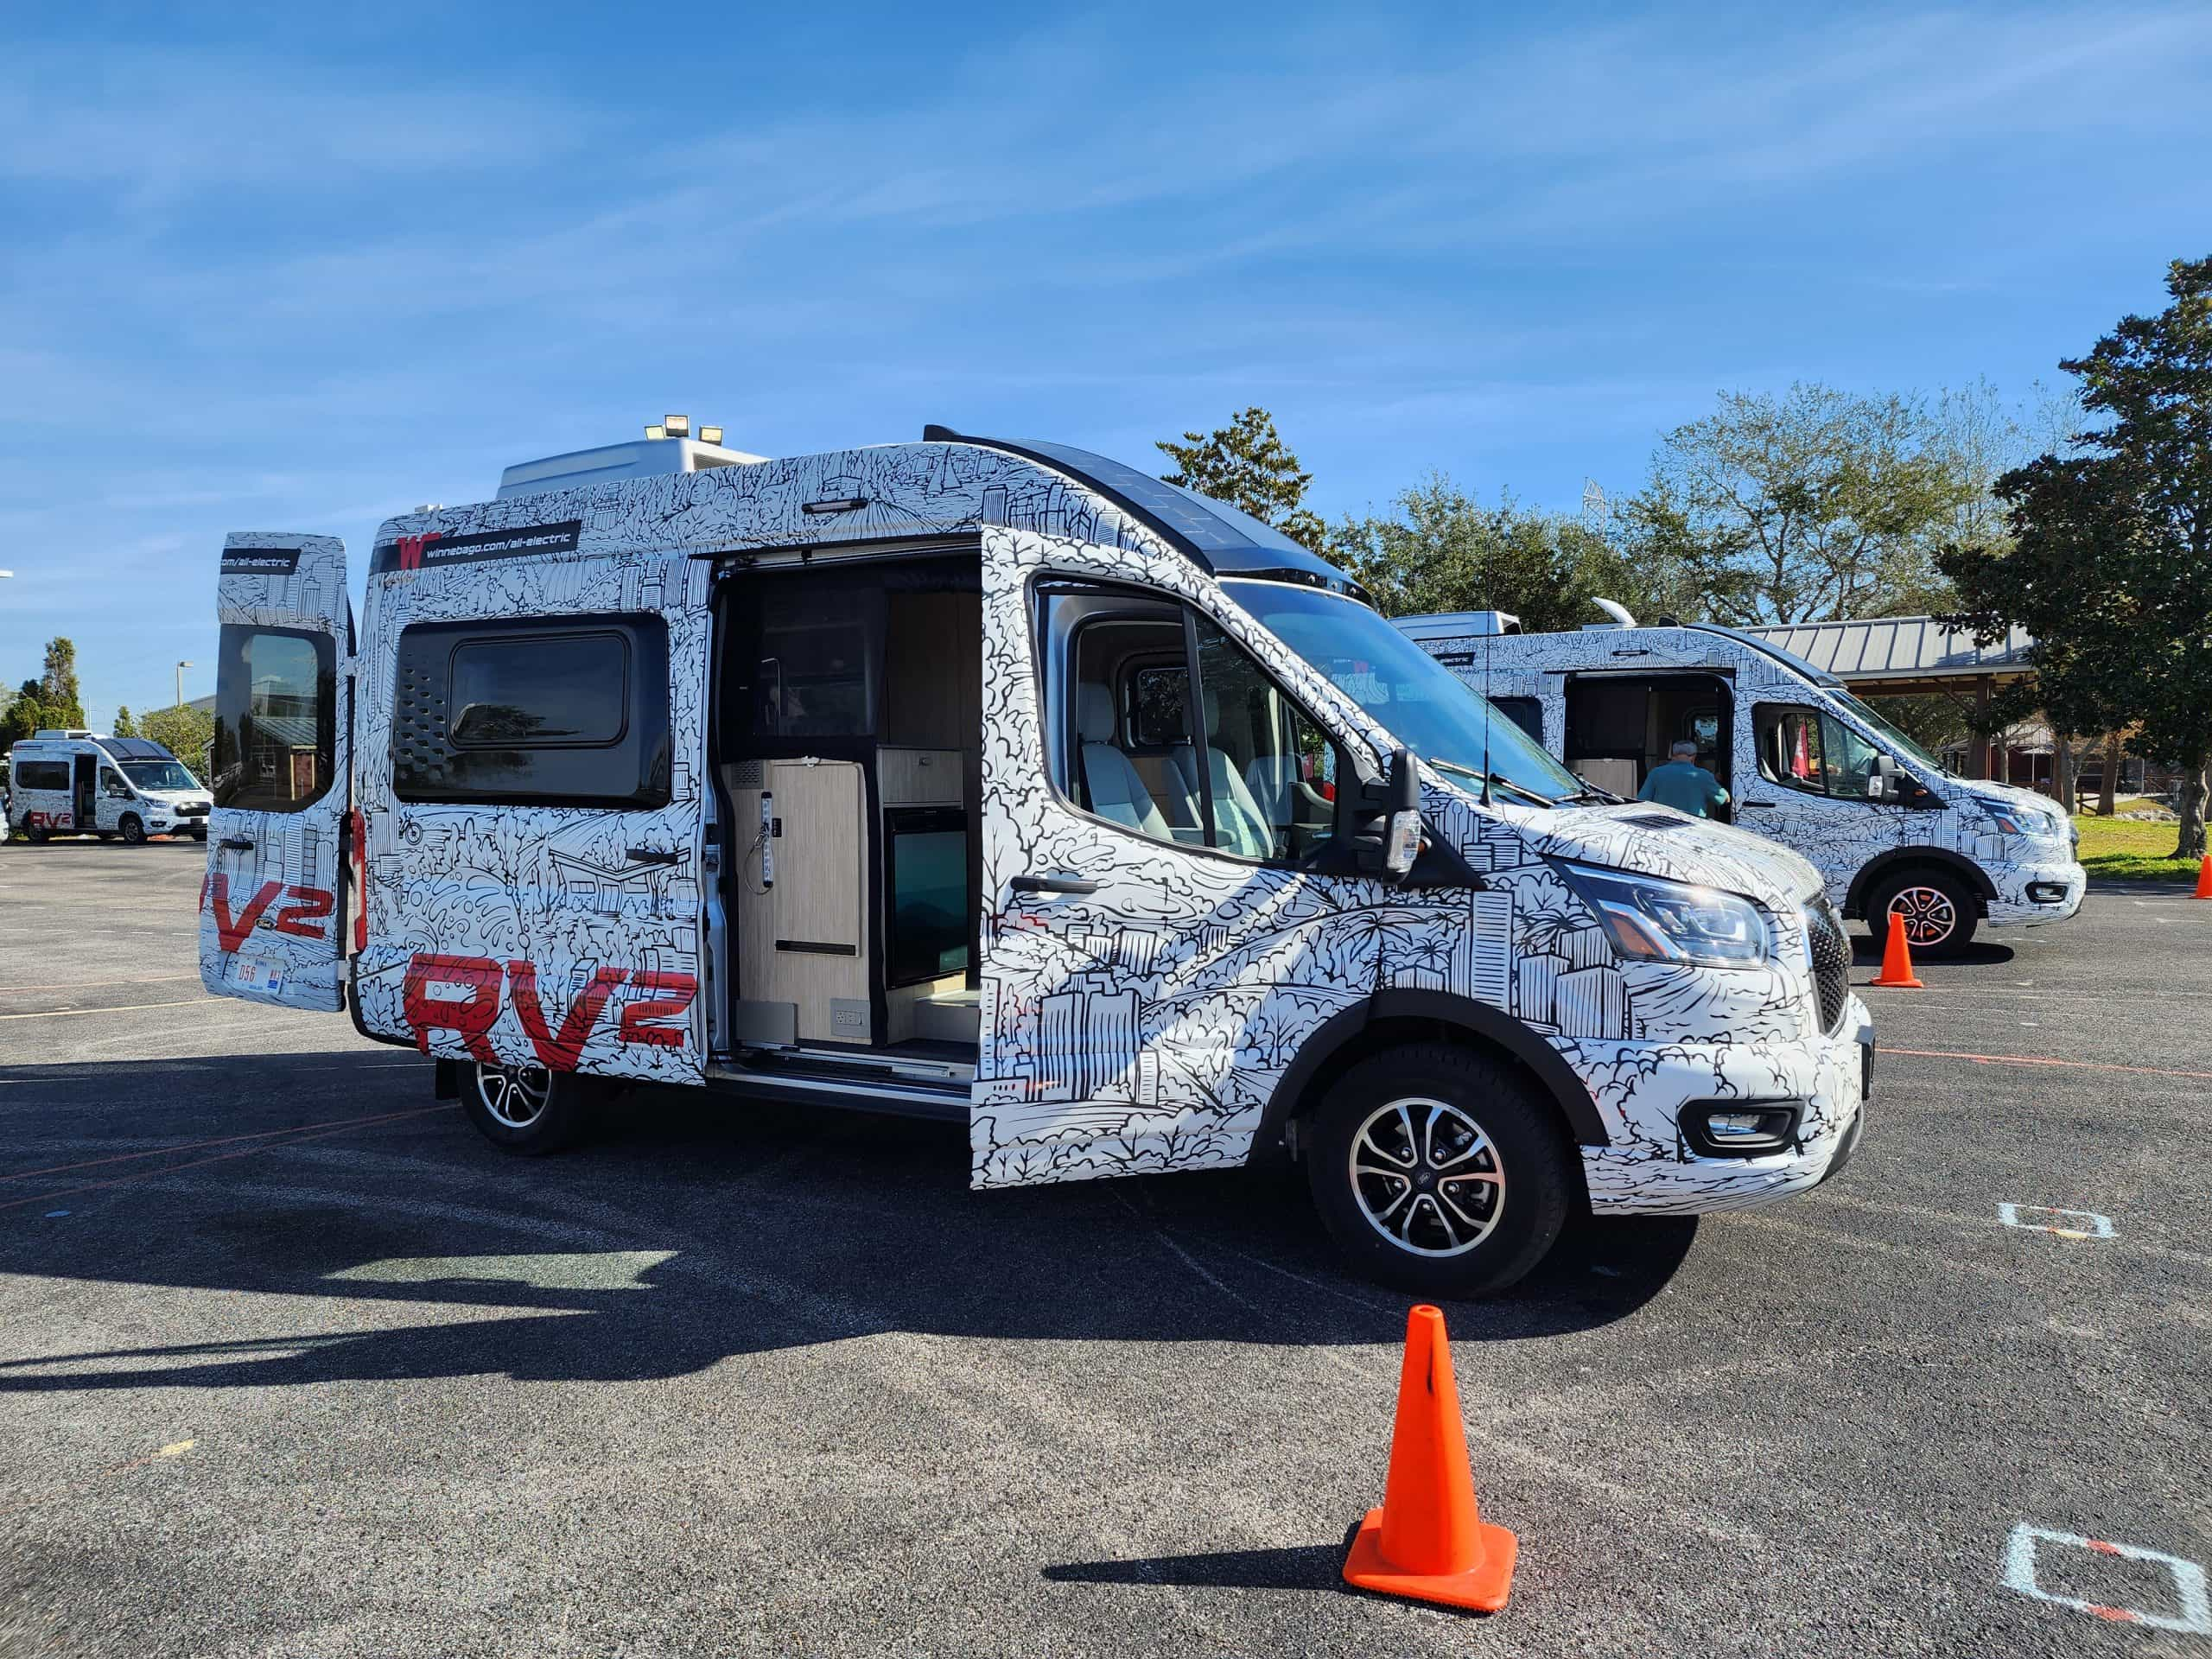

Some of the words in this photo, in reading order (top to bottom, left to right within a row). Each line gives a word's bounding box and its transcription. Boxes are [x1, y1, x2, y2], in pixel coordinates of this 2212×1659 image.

[426, 531, 571, 559] winnebago.com/all-electric
[29, 811, 72, 830] RV2
[403, 952, 697, 1072] RV2
